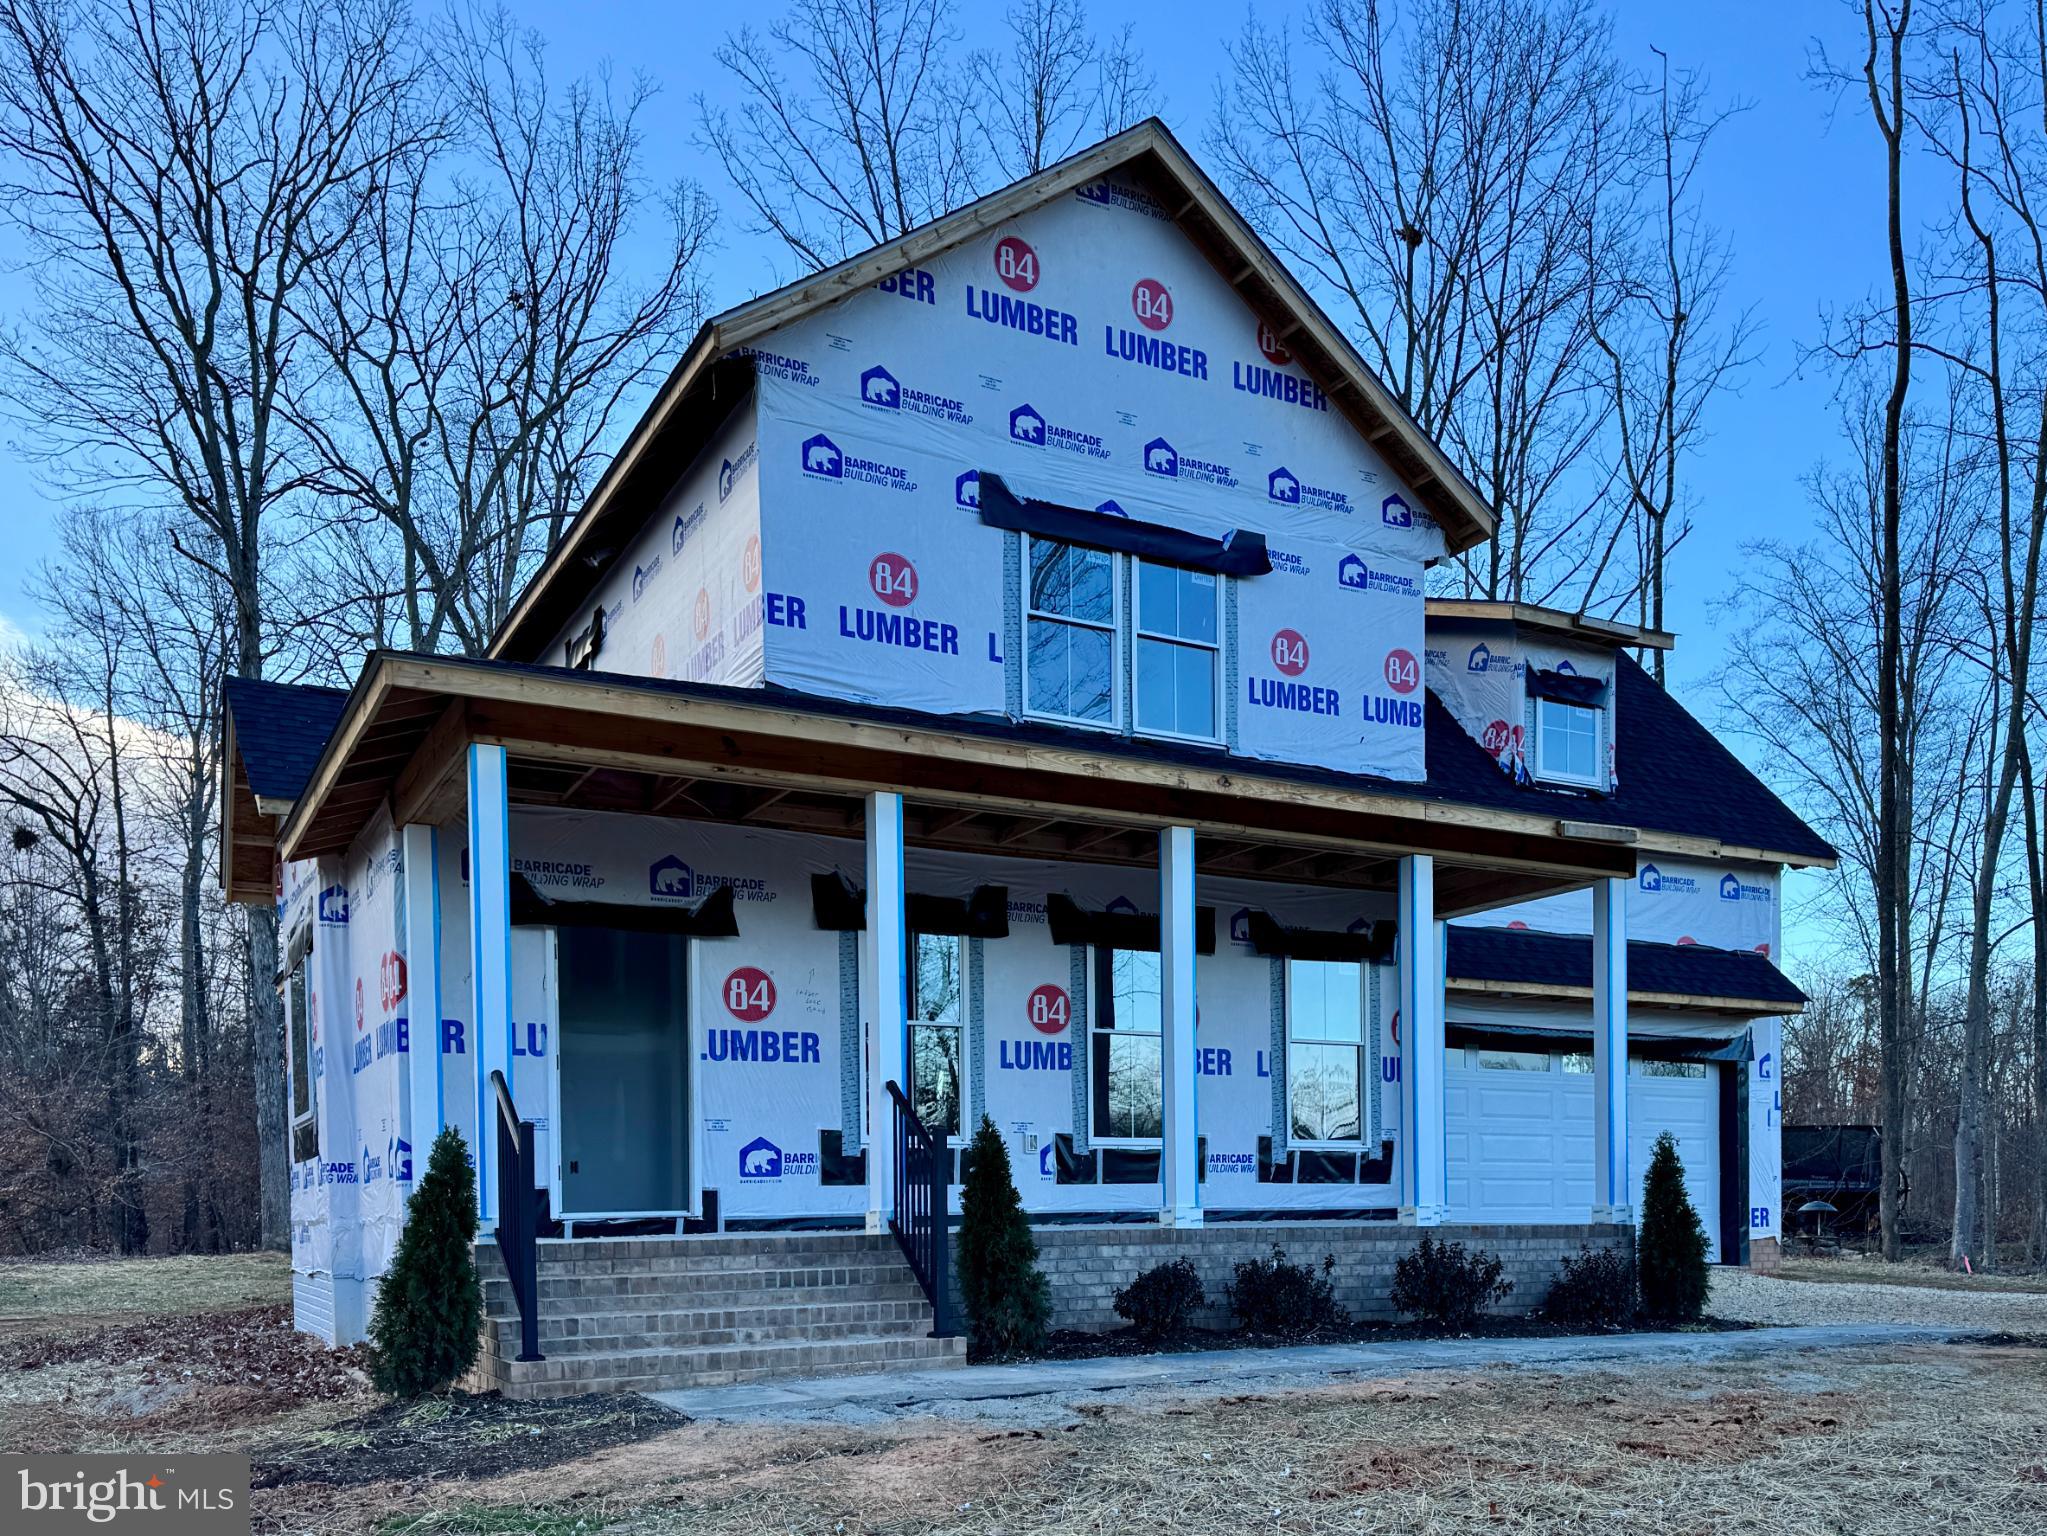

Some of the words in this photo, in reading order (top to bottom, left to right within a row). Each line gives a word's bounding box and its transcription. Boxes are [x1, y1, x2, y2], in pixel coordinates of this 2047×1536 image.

[1111, 195, 1149, 216] BUILDING
[1000, 246, 1034, 284] 84
[873, 268, 935, 305] BER
[966, 284, 1078, 346] LUMBER
[1137, 287, 1168, 323] 84
[741, 346, 808, 374] BARRICADE
[1105, 325, 1208, 381] LUMBER
[791, 372, 820, 387] WRAP
[1233, 360, 1327, 412] LUMBER
[902, 387, 963, 412] BARRICADE
[901, 400, 944, 419] BUILDING
[946, 410, 973, 425] WRAP
[1047, 425, 1102, 447] BARRICADE
[1047, 436, 1085, 454] BUILDING
[1087, 446, 1111, 459] WRAP
[844, 456, 907, 480] BARRICADE
[1179, 457, 1230, 477] BARRICADE
[1179, 468, 1214, 484] BUILDING
[1216, 475, 1239, 489] WRAP
[844, 468, 888, 487] BUILDING
[890, 478, 917, 493] WRAP
[1301, 485, 1347, 504] BARRICADE
[1301, 495, 1332, 511] BUILDING
[1333, 502, 1354, 515] WRAP
[876, 562, 913, 598] 84
[1289, 564, 1310, 577] WRAP
[1369, 570, 1413, 588] BARRICADE
[1368, 581, 1400, 595] BUILDING
[1401, 586, 1421, 598] WRAP
[839, 605, 959, 656] LUMBER
[1275, 637, 1305, 668] 84
[1388, 657, 1417, 686] 84
[1248, 677, 1340, 717] LUMBER
[1363, 695, 1423, 728] LUMB
[514, 858, 592, 876] BARRICADE
[572, 876, 605, 889] WRAP
[696, 874, 765, 891] BARRICADE
[747, 889, 777, 903] WRAP
[729, 978, 771, 1012] 84
[1032, 994, 1066, 1024] 84
[700, 1028, 821, 1064] UMBER
